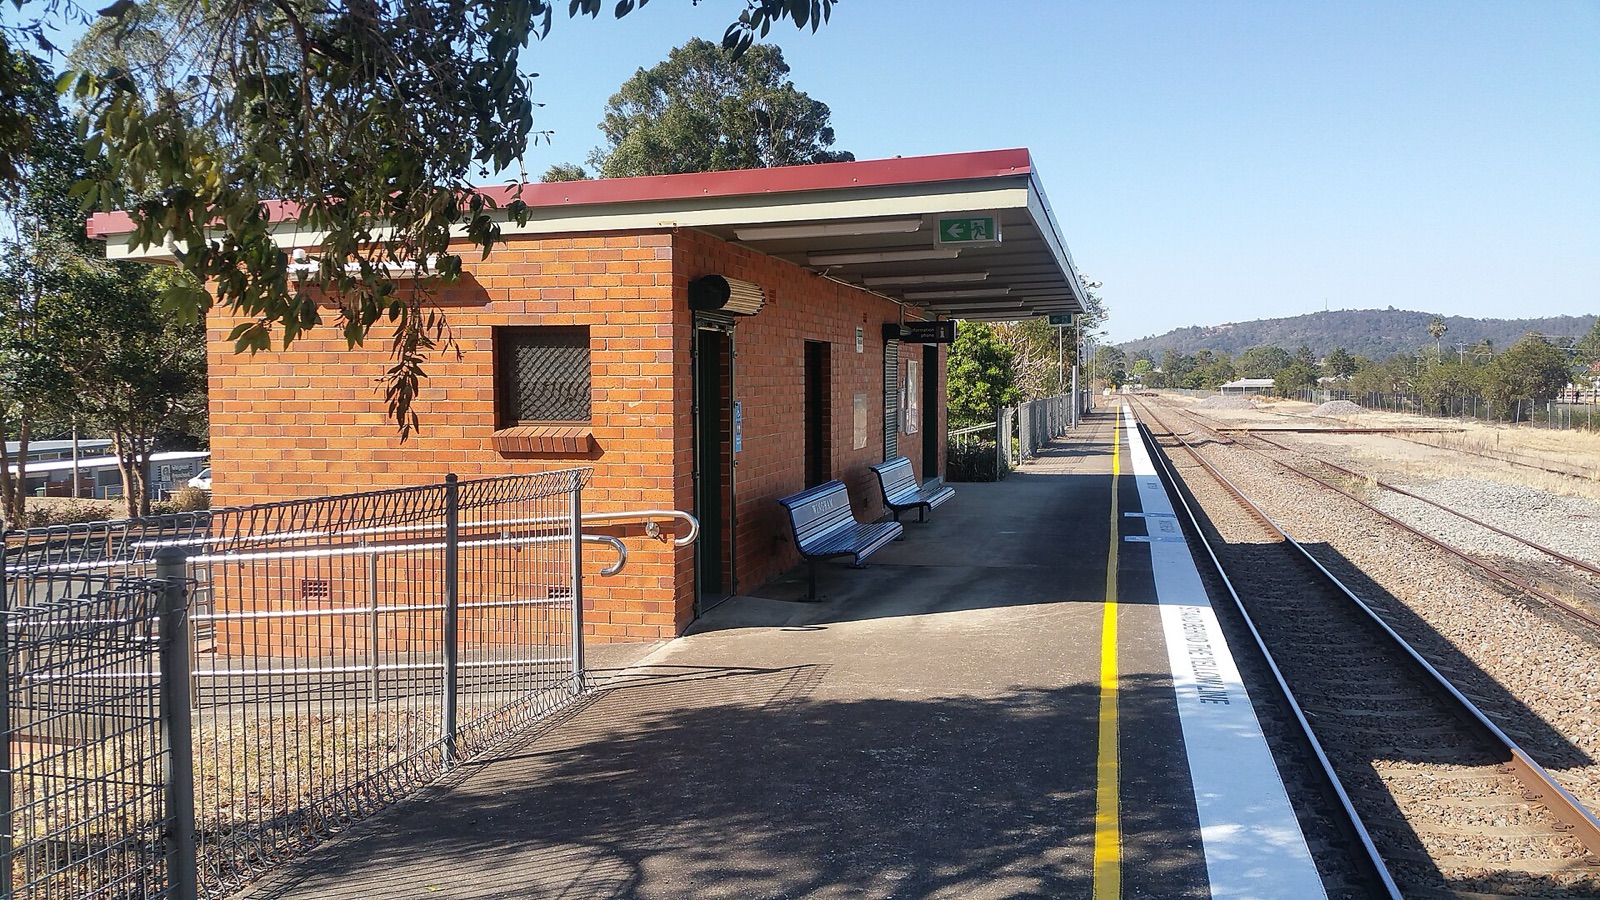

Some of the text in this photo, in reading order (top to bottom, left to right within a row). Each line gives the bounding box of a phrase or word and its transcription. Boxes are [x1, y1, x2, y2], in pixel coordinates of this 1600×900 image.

[1183, 623, 1208, 642] BEHIND
[1187, 644, 1213, 655] THE
[1190, 656, 1224, 685] YELLOW
[1197, 685, 1230, 705] LINE
